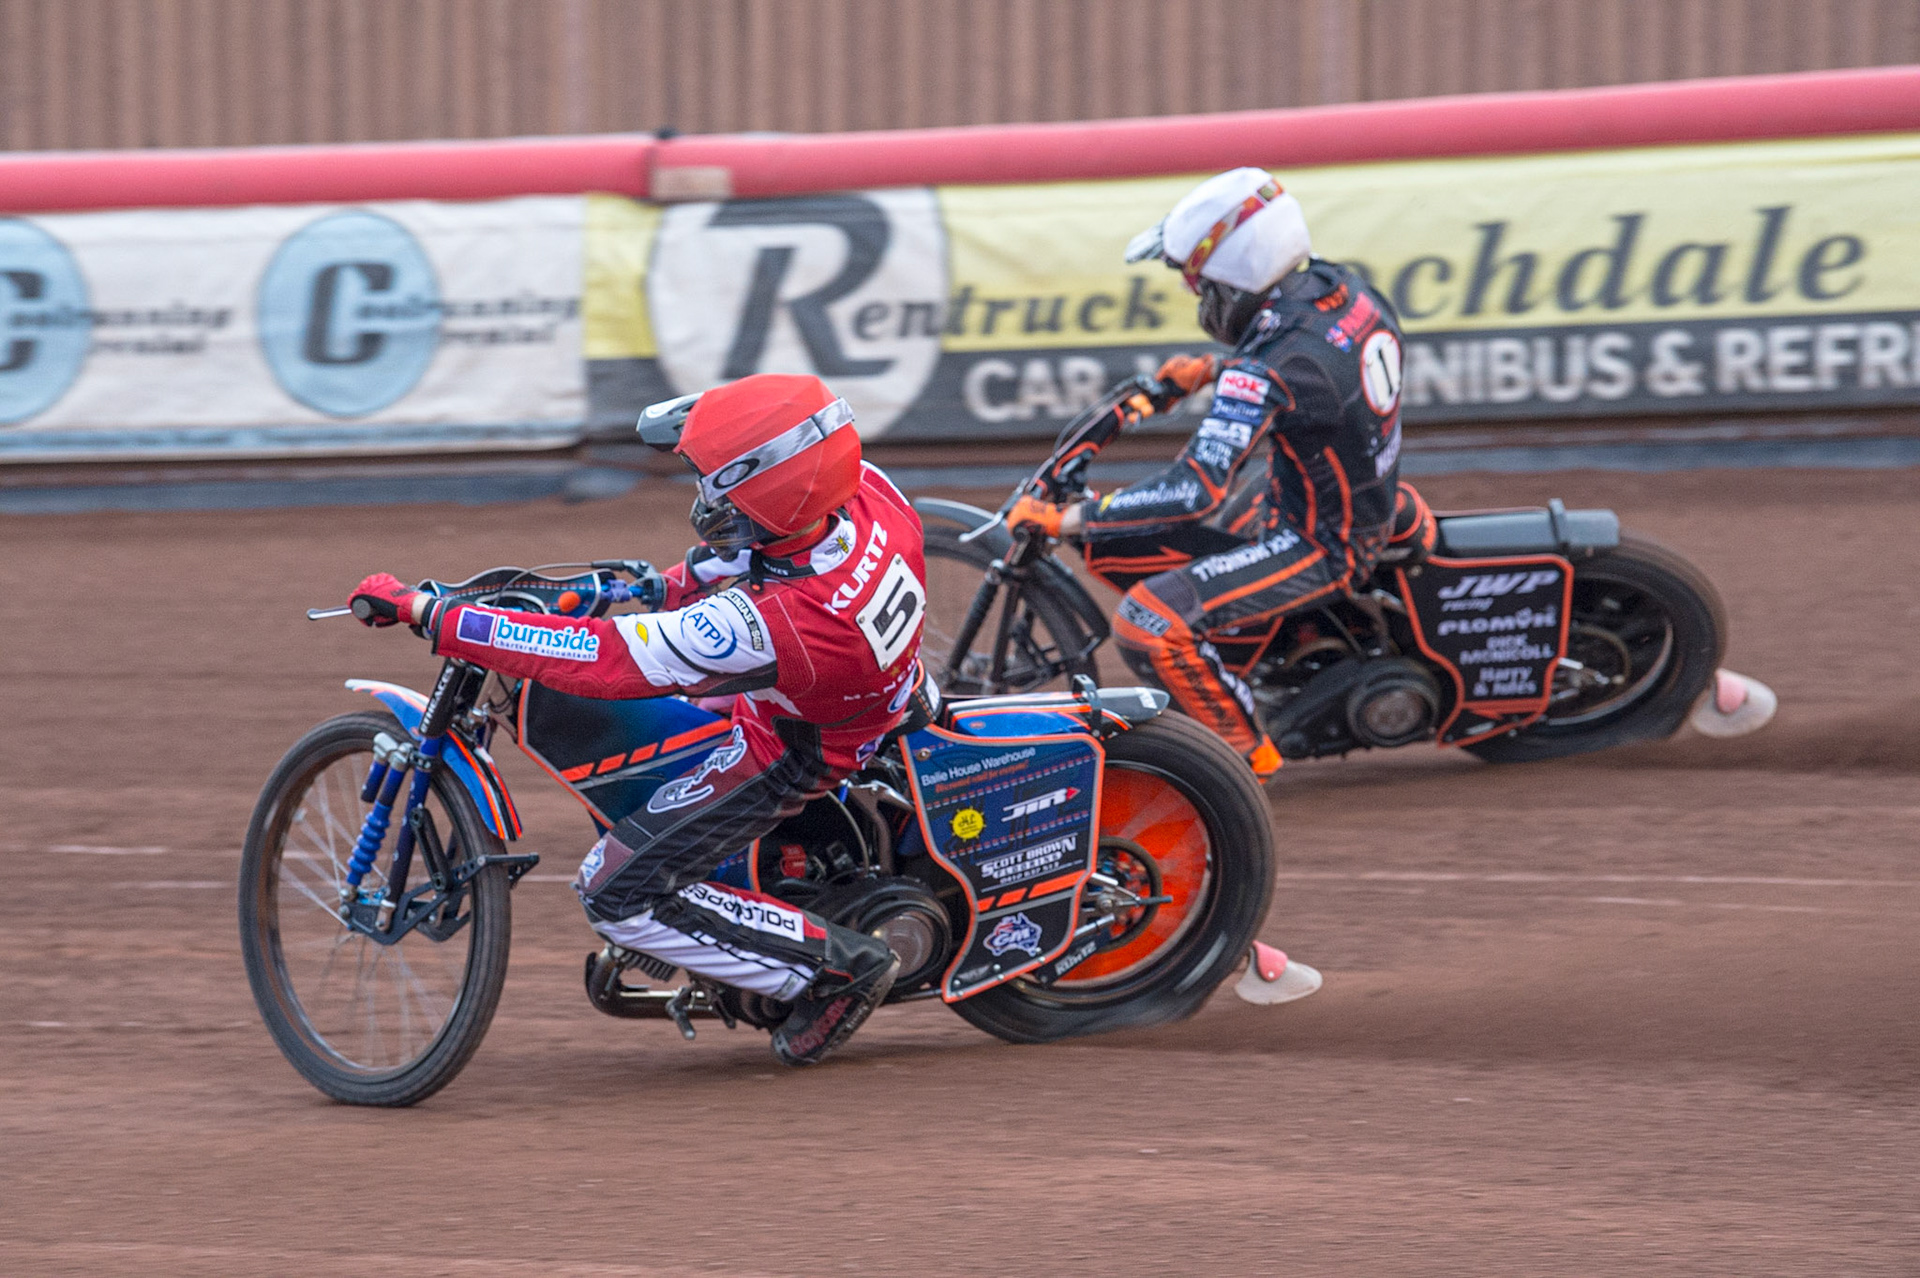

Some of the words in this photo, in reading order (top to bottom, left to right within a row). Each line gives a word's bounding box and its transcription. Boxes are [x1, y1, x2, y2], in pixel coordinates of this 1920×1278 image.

[1342, 204, 1868, 326] chdale
[1402, 330, 1636, 405] NIBUS
[1648, 329, 1704, 398] &
[823, 520, 889, 615] KURTZ
[1437, 569, 1561, 600] JWP
[687, 610, 727, 650] ATPI
[871, 574, 919, 652] 5
[494, 640, 539, 654] chartered
[541, 647, 598, 661] accountants
[497, 618, 598, 652] burnside
[948, 762, 981, 780] House
[981, 747, 1036, 770] Warehouse
[982, 853, 1024, 878] SCOTT
[1026, 837, 1077, 860] BROWN
